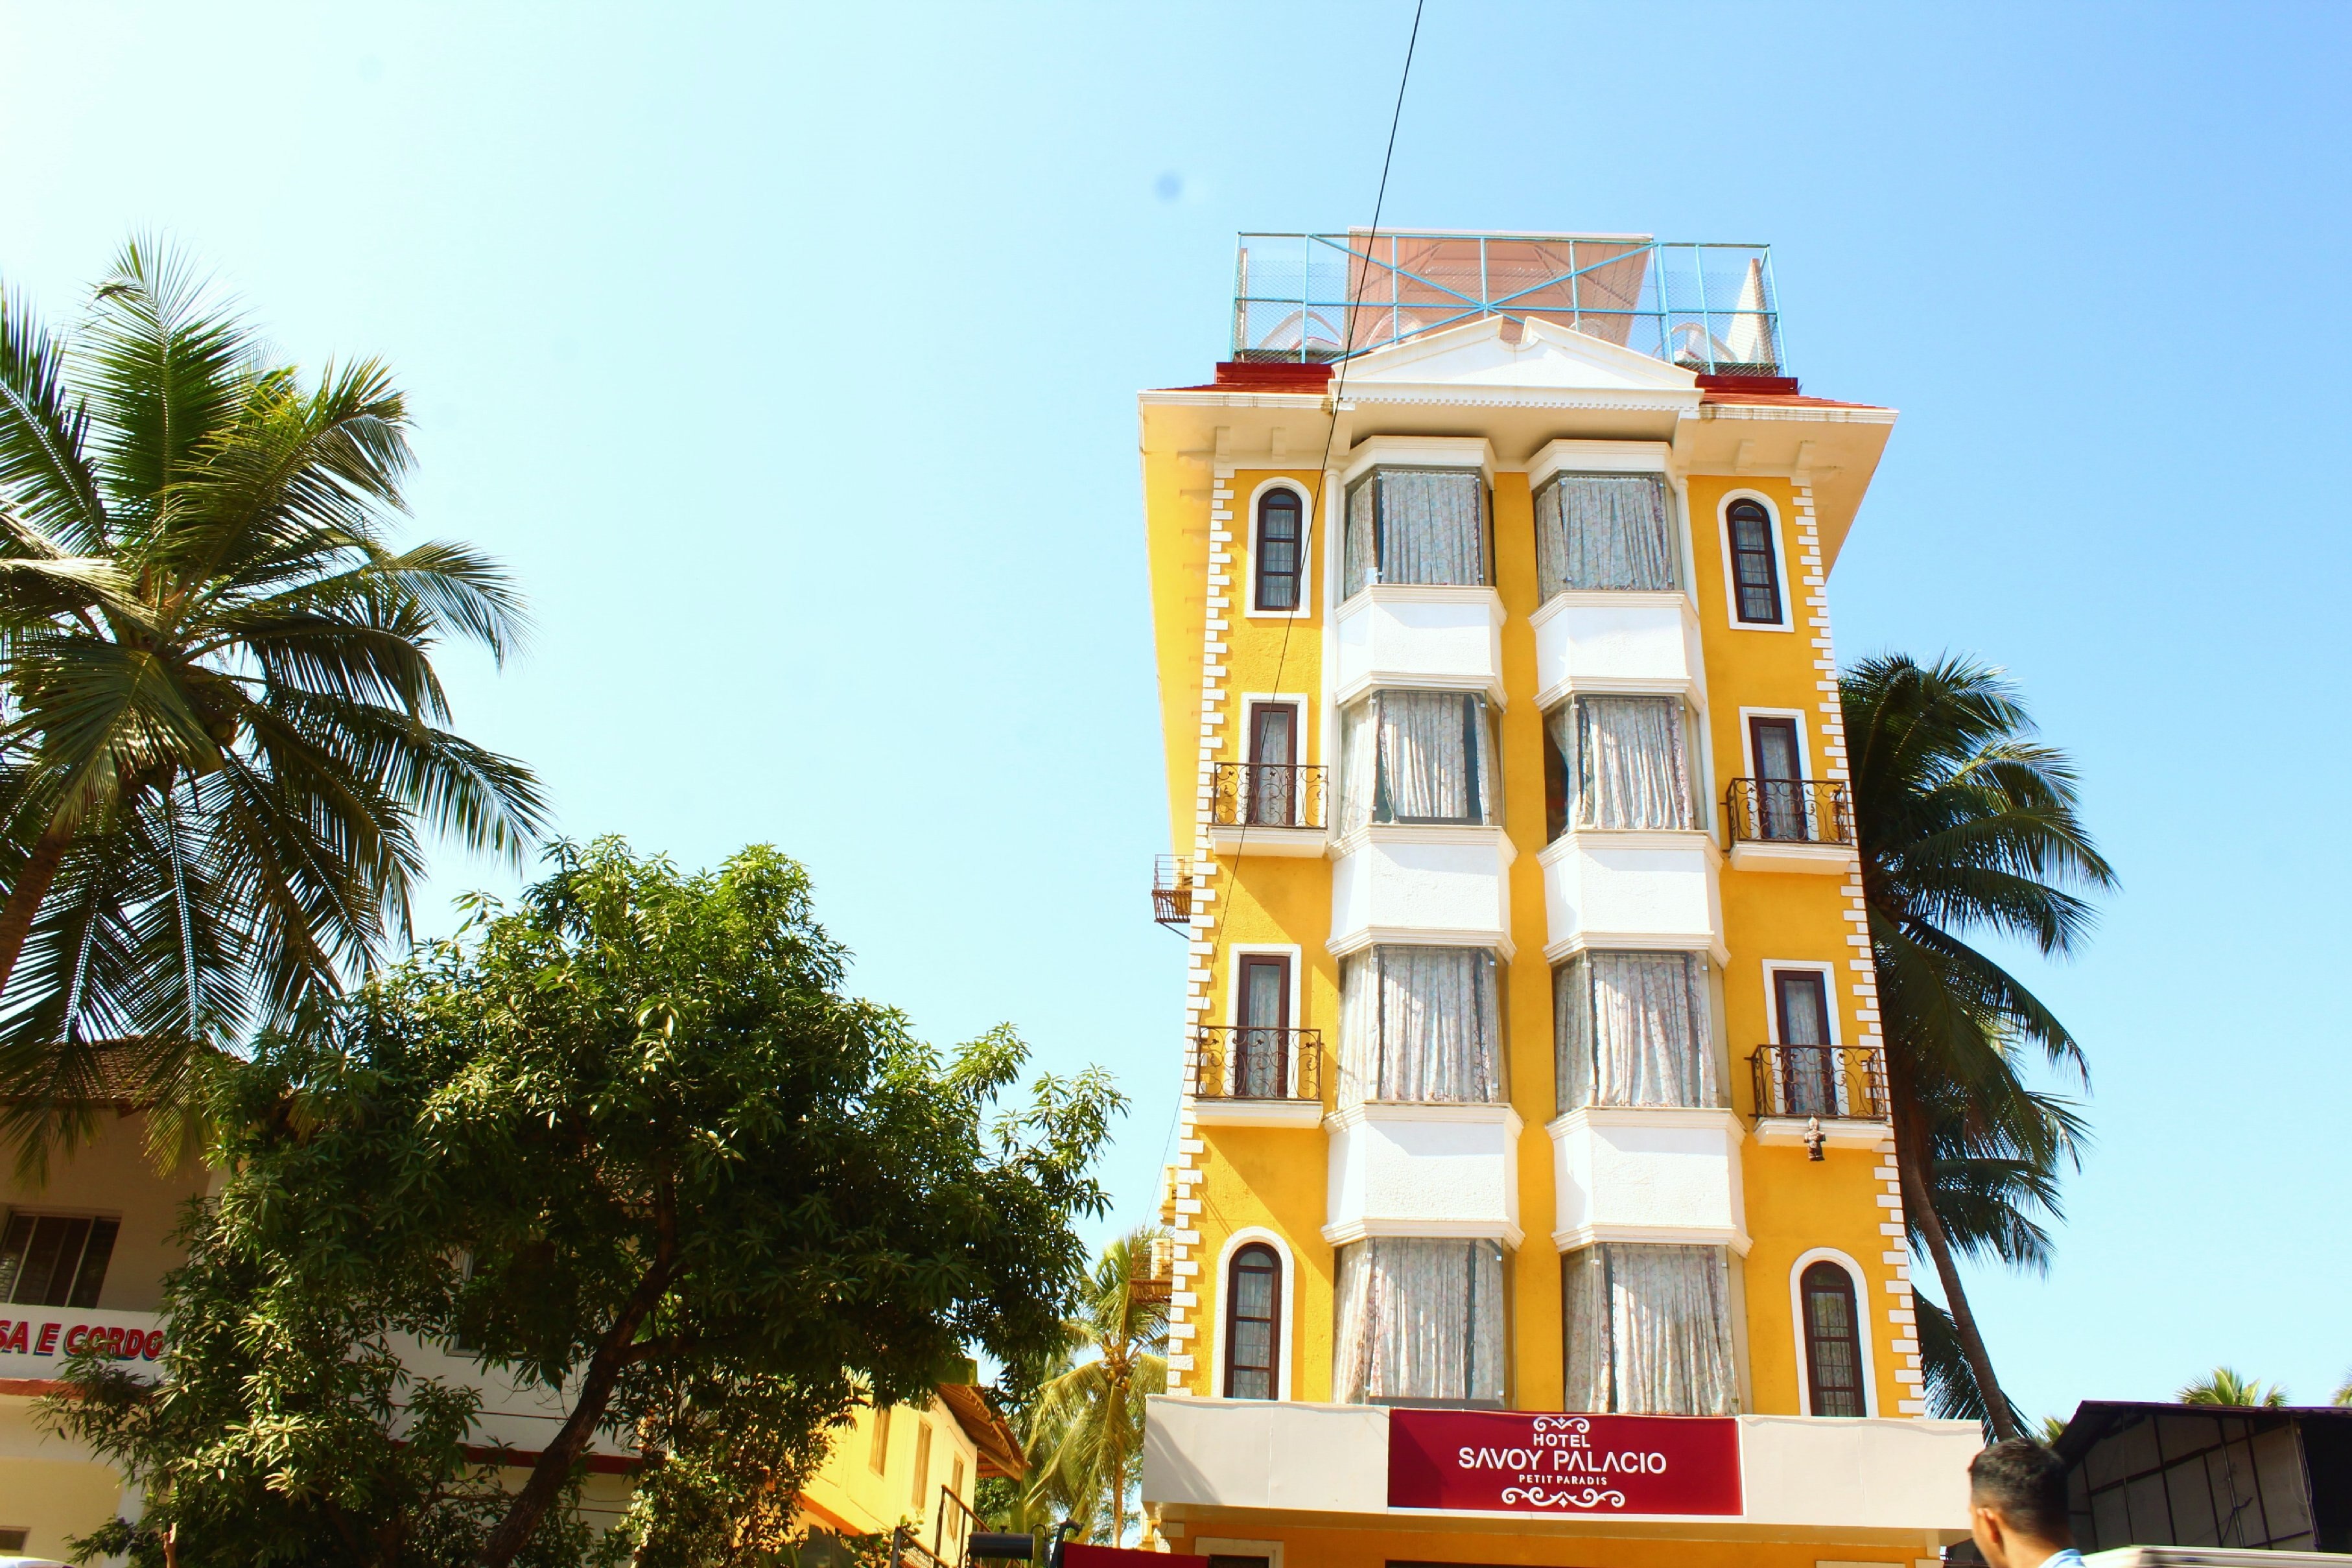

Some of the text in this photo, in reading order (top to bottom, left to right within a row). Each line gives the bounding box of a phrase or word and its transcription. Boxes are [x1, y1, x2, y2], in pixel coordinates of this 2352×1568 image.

[34, 1322, 62, 1356] E
[1533, 1433, 1591, 1447] HOTEL
[1458, 1447, 1667, 1473] SAVOY PALACIO
[1519, 1474, 1608, 1486] PETIT PARADIS
